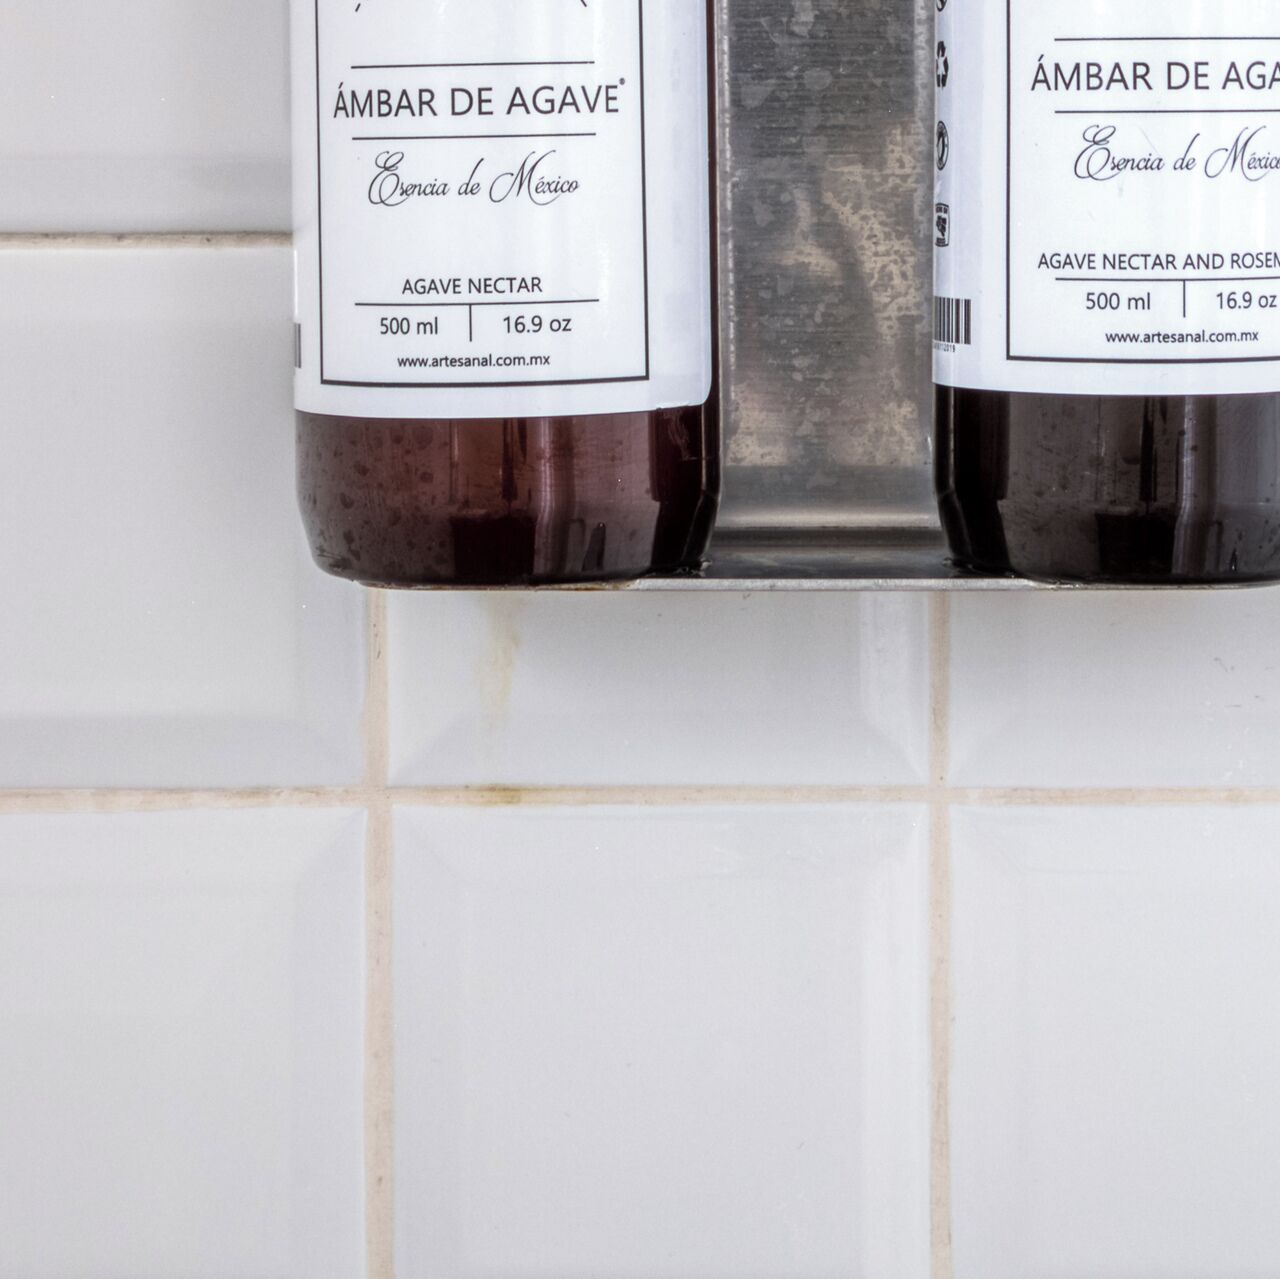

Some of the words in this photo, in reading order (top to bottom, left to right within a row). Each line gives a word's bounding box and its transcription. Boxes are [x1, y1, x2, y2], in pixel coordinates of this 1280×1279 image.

[1030, 53, 1154, 92] ÁMBAR
[1166, 60, 1211, 91] DE
[332, 81, 439, 119] ÁMBAR
[450, 86, 495, 117] DE
[1073, 124, 1166, 182] Esencia
[1172, 132, 1199, 172] de
[367, 150, 451, 208] Esencia
[457, 157, 485, 197] de
[488, 149, 580, 207] México
[1037, 252, 1097, 271] AGAVE
[1102, 252, 1178, 271] NECTAR
[1181, 252, 1225, 271] AND
[401, 277, 463, 296] AGAVE
[467, 276, 543, 295] NECTAR
[1085, 291, 1121, 311] 500
[1127, 291, 1151, 311] ml
[1215, 290, 1253, 310] 16.9
[1257, 294, 1278, 309] oz
[379, 316, 411, 336] 500
[416, 315, 439, 336] ml
[502, 314, 543, 335] 16.9
[549, 317, 573, 333] oz
[1104, 328, 1259, 344] www.artesanal.com.mx
[396, 352, 551, 368] www.artesanal.com.mx
